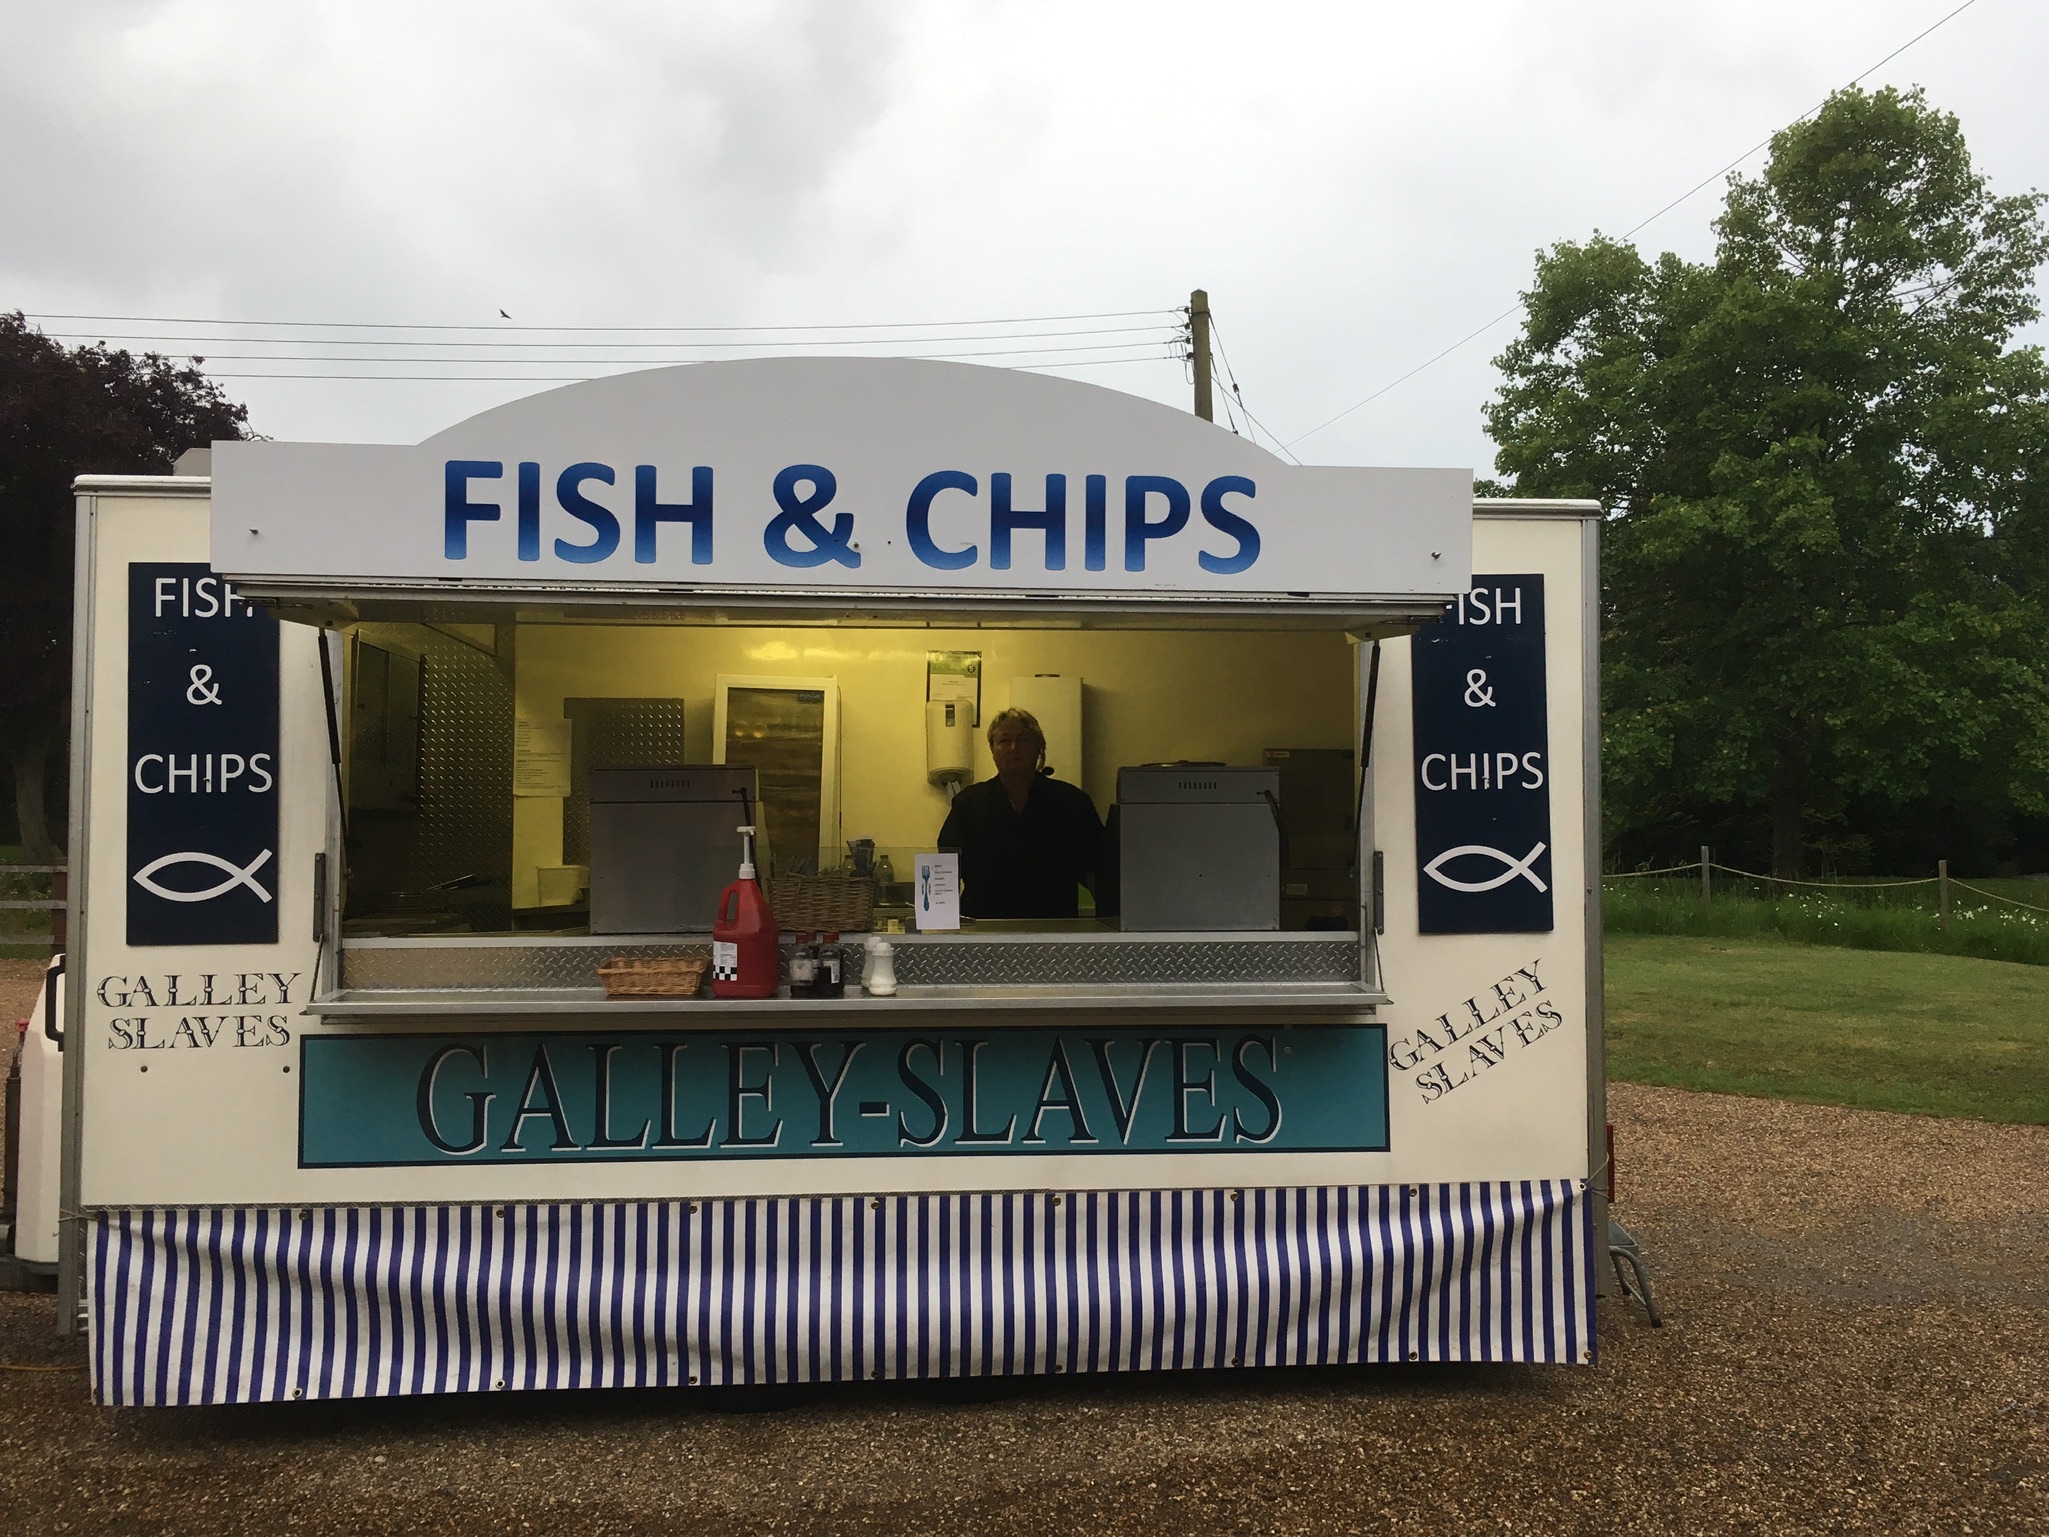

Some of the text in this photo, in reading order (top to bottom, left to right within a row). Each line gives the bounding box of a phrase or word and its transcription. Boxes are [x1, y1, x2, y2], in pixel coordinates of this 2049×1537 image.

[445, 460, 1261, 574] FISH & CHIPS
[1445, 587, 1521, 625] ISH
[186, 664, 223, 705] &
[1464, 668, 1496, 708] &
[134, 753, 273, 794] CHIPS
[1421, 751, 1544, 791] CHIPS
[97, 973, 302, 1008] GALLEY
[108, 1015, 290, 1050] SLAVES
[1389, 958, 1548, 1071] GALLEY
[1415, 1000, 1563, 1105] SLAVES
[416, 1035, 1282, 1156] GALLEY-SLAVES
